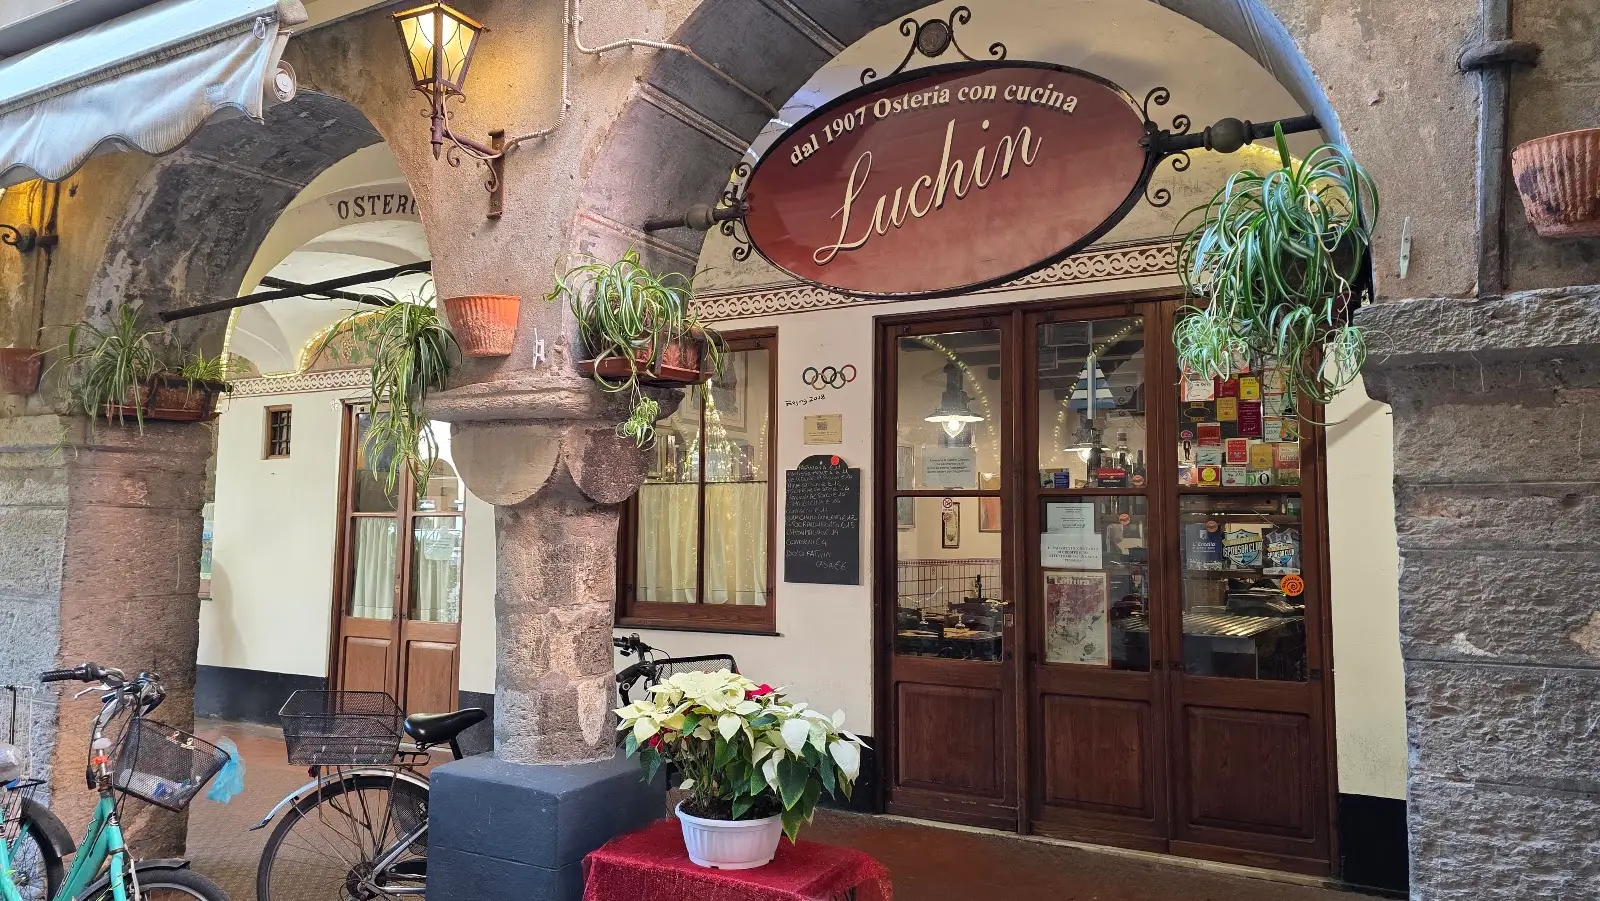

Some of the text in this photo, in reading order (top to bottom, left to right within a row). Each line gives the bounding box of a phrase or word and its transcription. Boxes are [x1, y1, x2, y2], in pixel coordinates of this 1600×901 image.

[790, 83, 1078, 166] dal 1907 Osteria con cucina
[813, 118, 1042, 265] Luchin
